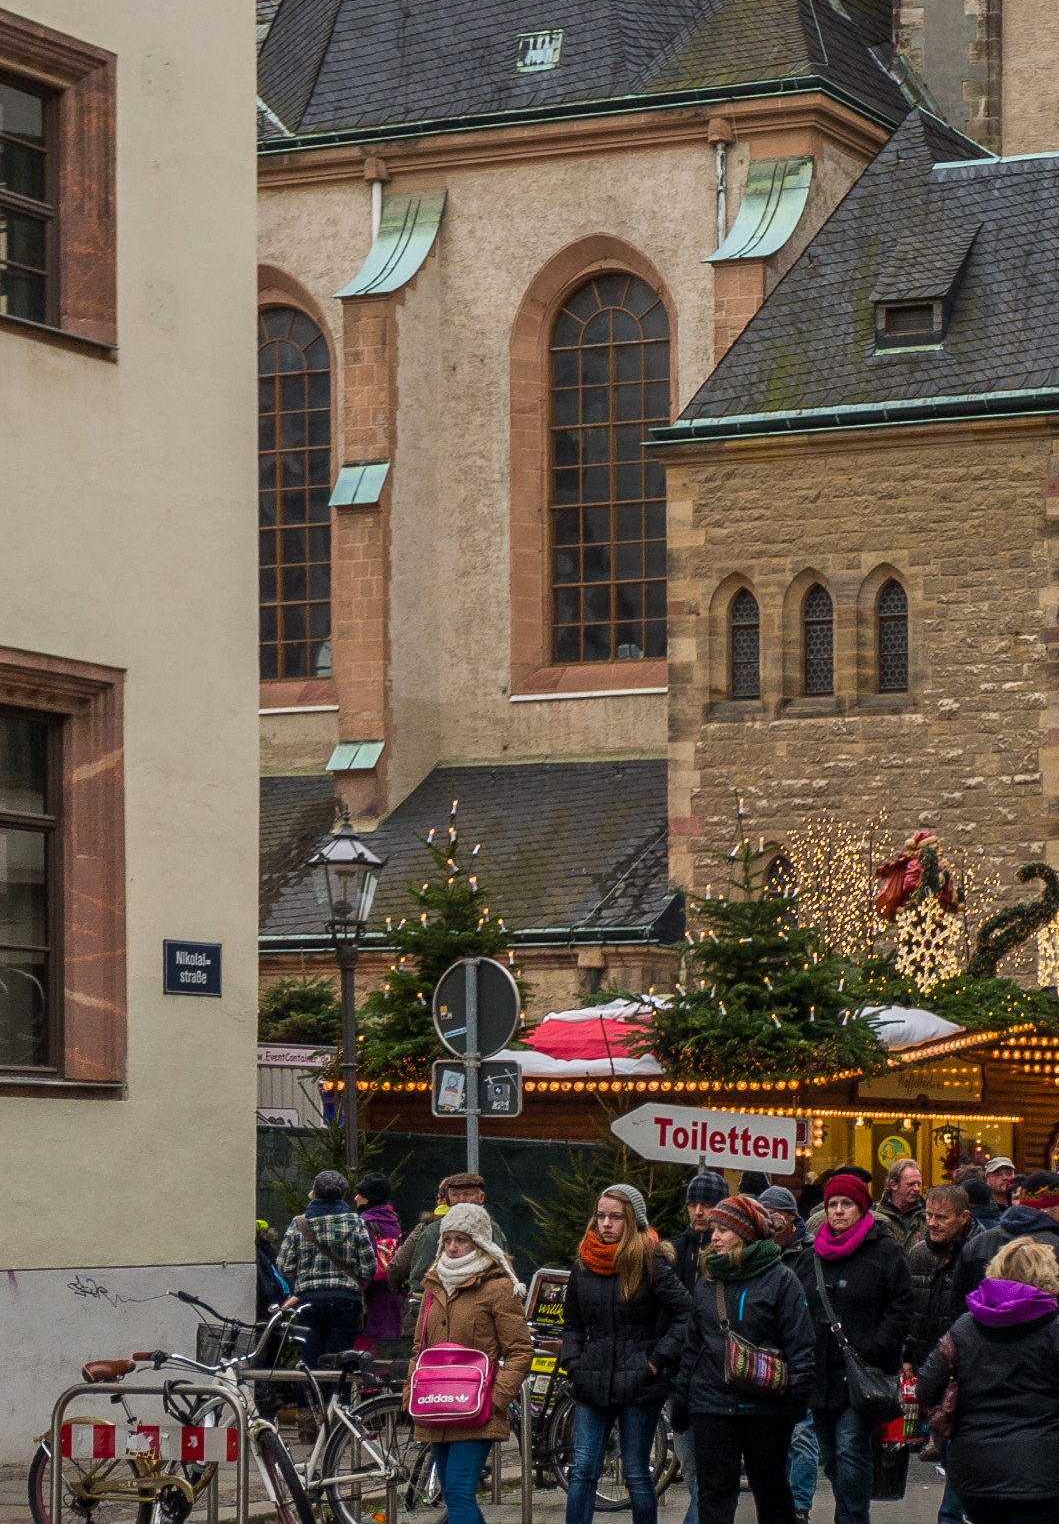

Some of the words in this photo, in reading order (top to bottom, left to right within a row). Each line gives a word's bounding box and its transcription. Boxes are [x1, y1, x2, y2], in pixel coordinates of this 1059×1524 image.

[179, 970, 208, 985] straße
[653, 1116, 789, 1161] Toiletten
[417, 1393, 455, 1405] adidas
